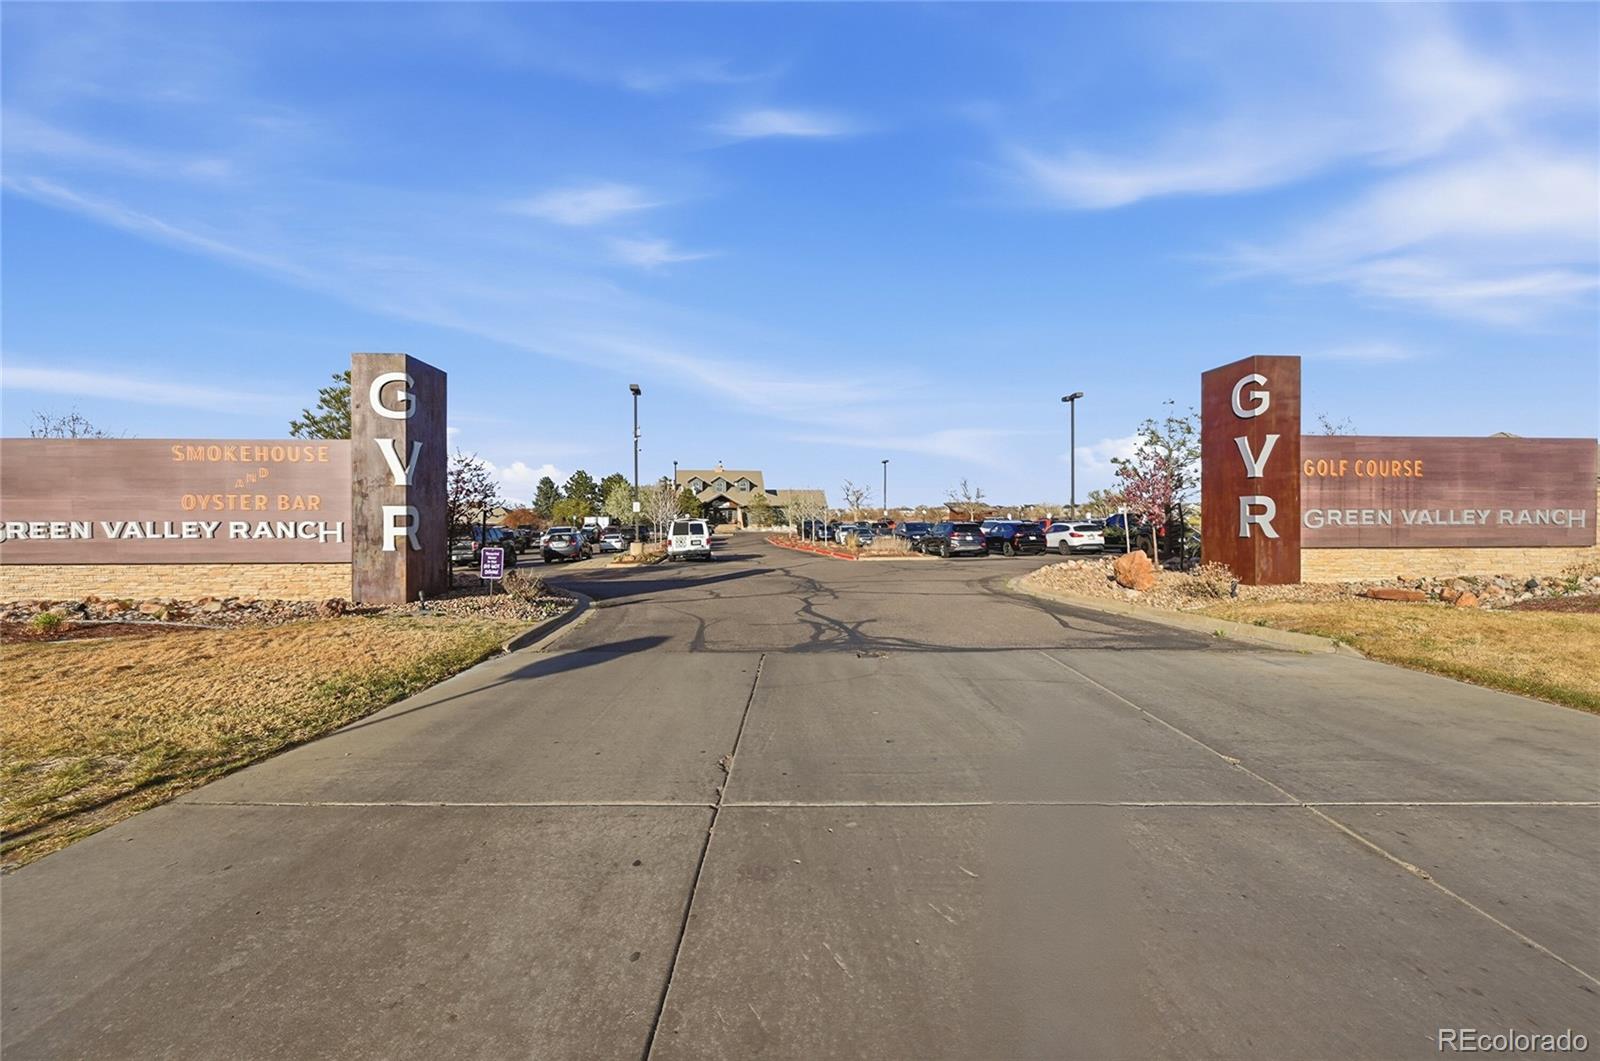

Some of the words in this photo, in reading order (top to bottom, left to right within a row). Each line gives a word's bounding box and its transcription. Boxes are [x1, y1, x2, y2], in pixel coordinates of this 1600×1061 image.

[171, 445, 329, 463] SMOKEHOUSE
[235, 467, 269, 488] AND
[1303, 460, 1349, 478] GOLF
[1354, 460, 1424, 478] COURSE
[180, 494, 268, 511] OYSTER
[277, 494, 322, 511] BAR
[1303, 509, 1392, 530] GREEN
[1401, 509, 1491, 525] VALLEY
[1497, 509, 1587, 529] RANCH
[100, 521, 223, 540] VALLEY
[229, 521, 344, 543] RANCH
